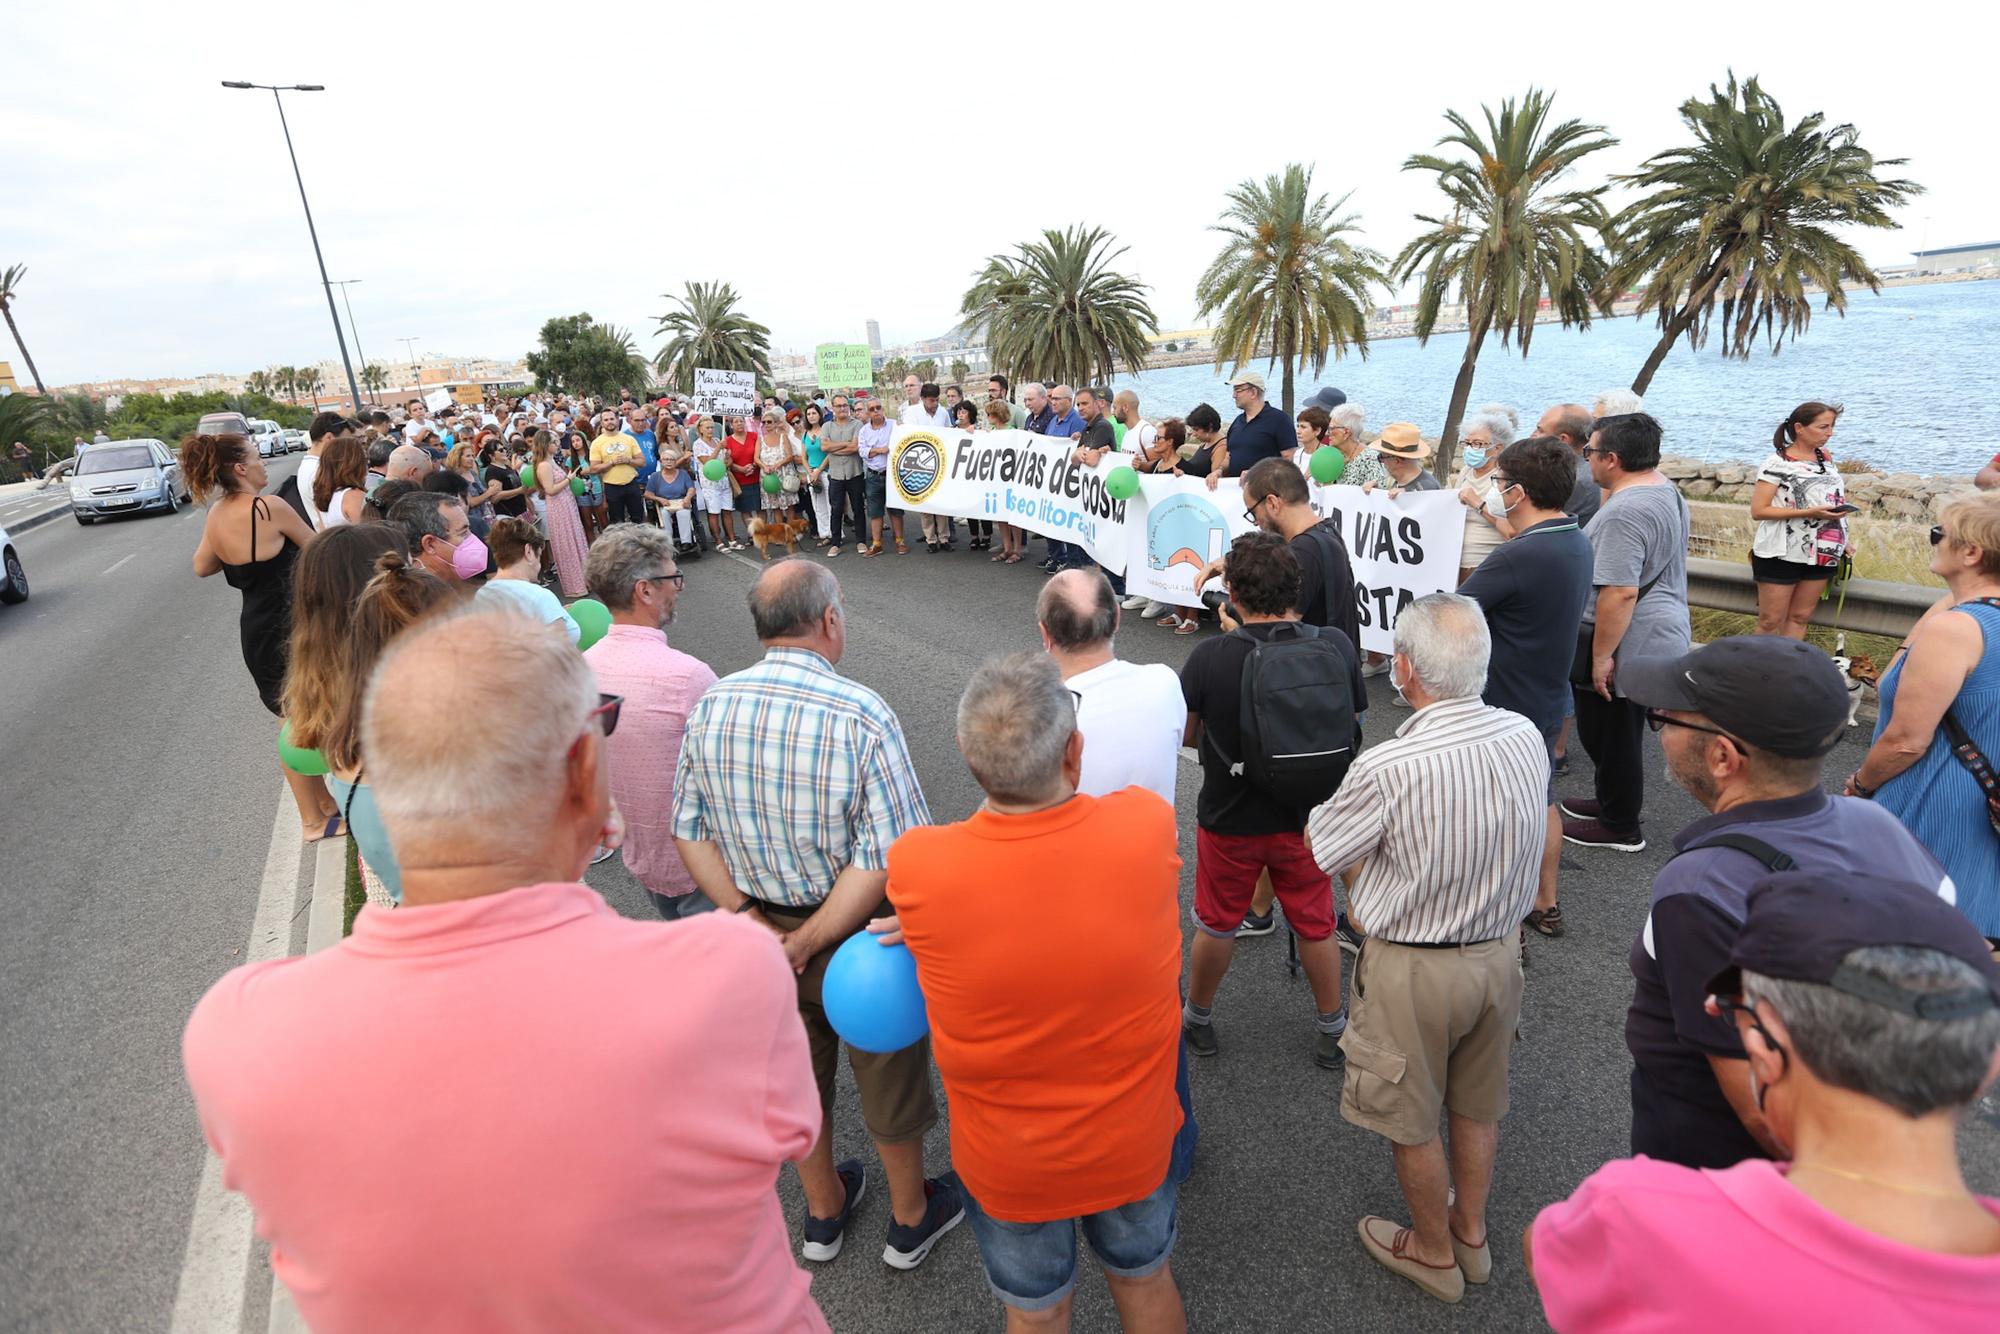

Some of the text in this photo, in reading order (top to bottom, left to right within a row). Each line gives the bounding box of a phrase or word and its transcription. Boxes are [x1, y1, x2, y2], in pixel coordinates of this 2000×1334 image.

[696, 370, 754, 388] Más de 30 años
[696, 384, 708, 397] de
[729, 388, 754, 402] muertas
[696, 397, 718, 413] ADIF
[951, 438, 1016, 482] Fuera
[1013, 439, 1047, 490] vías
[1049, 447, 1080, 499] de
[1355, 581, 1415, 632] STA
